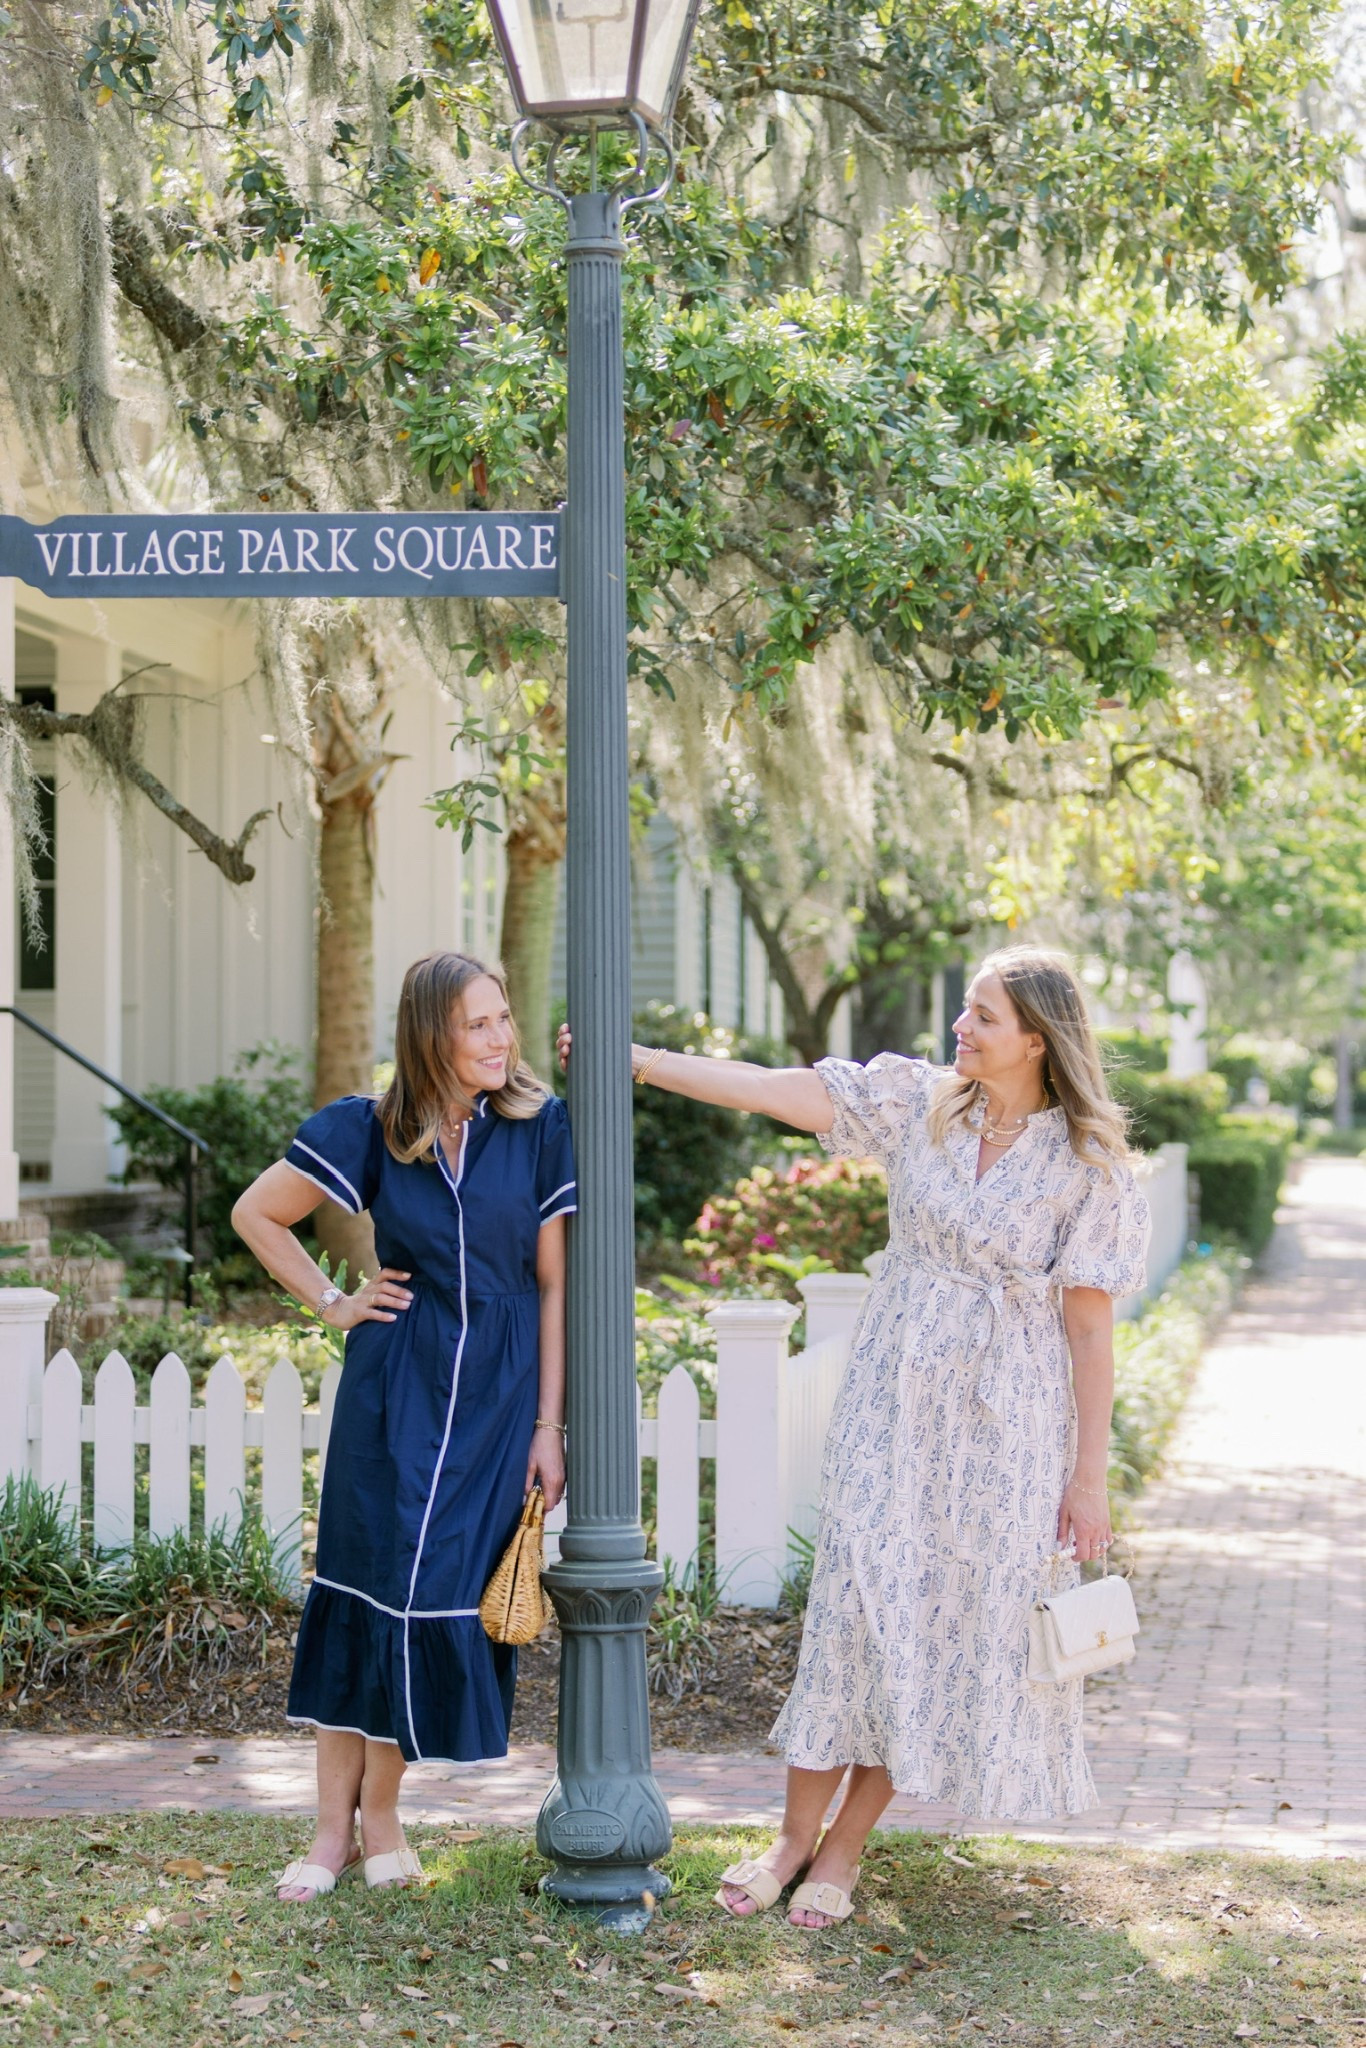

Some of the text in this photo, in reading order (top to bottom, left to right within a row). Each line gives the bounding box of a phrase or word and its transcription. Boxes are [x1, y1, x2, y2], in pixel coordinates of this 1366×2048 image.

[34, 525, 557, 579] VILLAGE PARK SQUARE
[554, 1824, 622, 1836] PALMETTO
[569, 1841, 605, 1851] BLUFF
